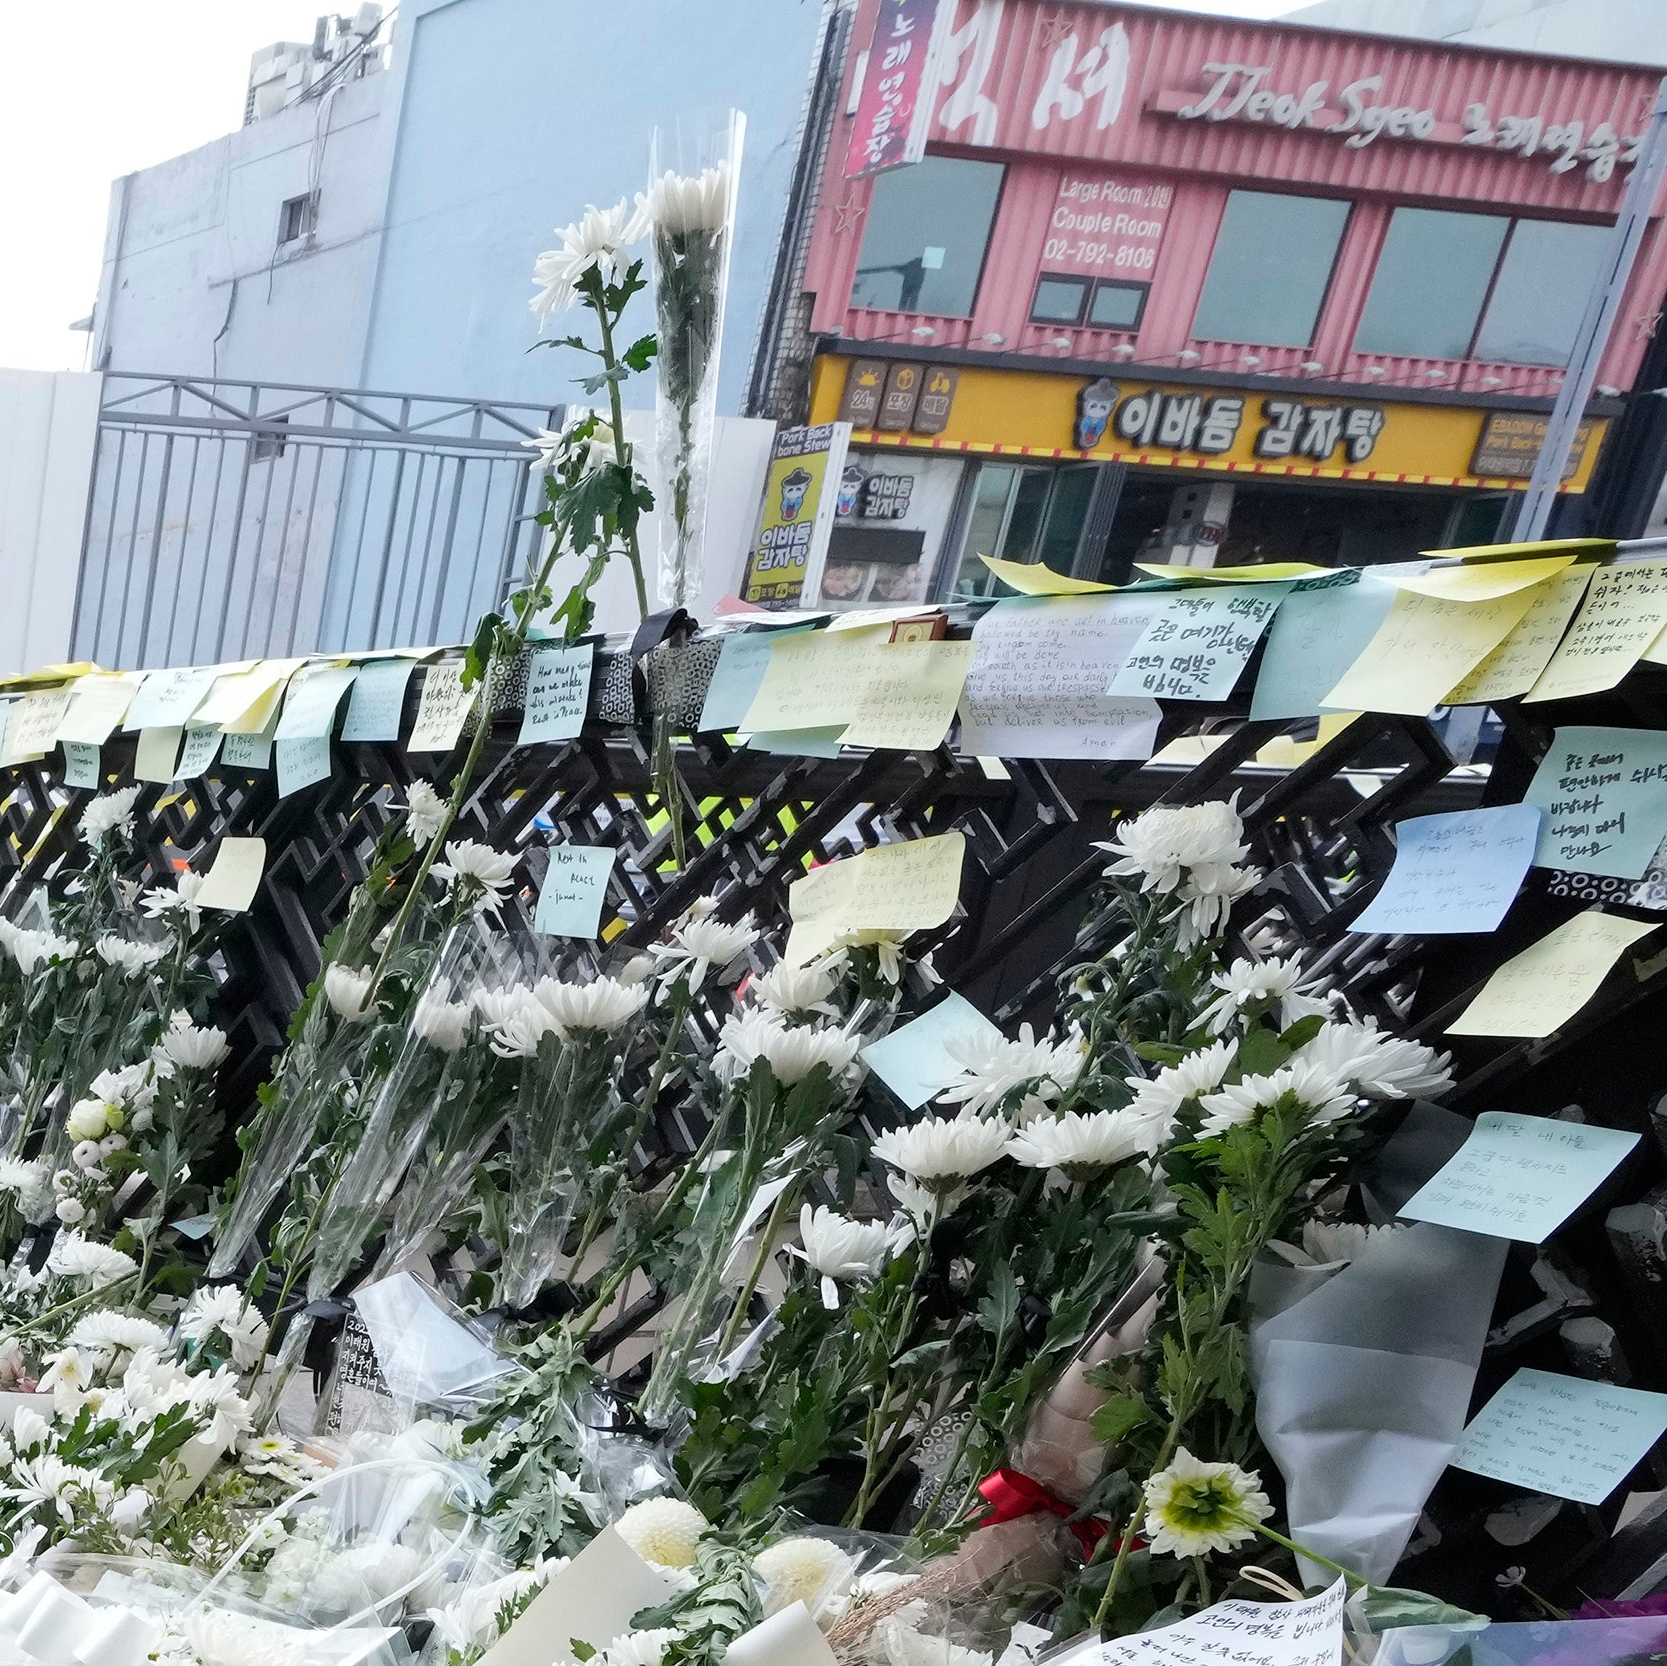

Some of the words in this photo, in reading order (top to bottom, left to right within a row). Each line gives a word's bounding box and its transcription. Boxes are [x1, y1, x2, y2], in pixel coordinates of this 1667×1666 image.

[1060, 176, 1100, 203] Large
[1100, 180, 1143, 203] Room
[1051, 205, 1111, 234] Couple
[1113, 213, 1162, 238] Room
[781, 430, 805, 446] Pork
[807, 425, 832, 441] Back
[1120, 391, 1244, 452] 이바돔
[1261, 401, 1383, 460] 감자탕
[777, 441, 802, 458] bone
[803, 438, 833, 454] Stew
[868, 474, 914, 498] 이바돔
[865, 496, 912, 520] 감자탕
[760, 521, 812, 548] 이바돔
[756, 544, 808, 572] 감자탕
[1126, 655, 1165, 670] 고인의
[1170, 654, 1216, 684] 명복을
[345, 1333, 371, 1353] 이태원
[1223, 1602, 1263, 1620] 이태원
[1196, 1613, 1244, 1632] 고인의
[1244, 1622, 1287, 1640] 명복을
